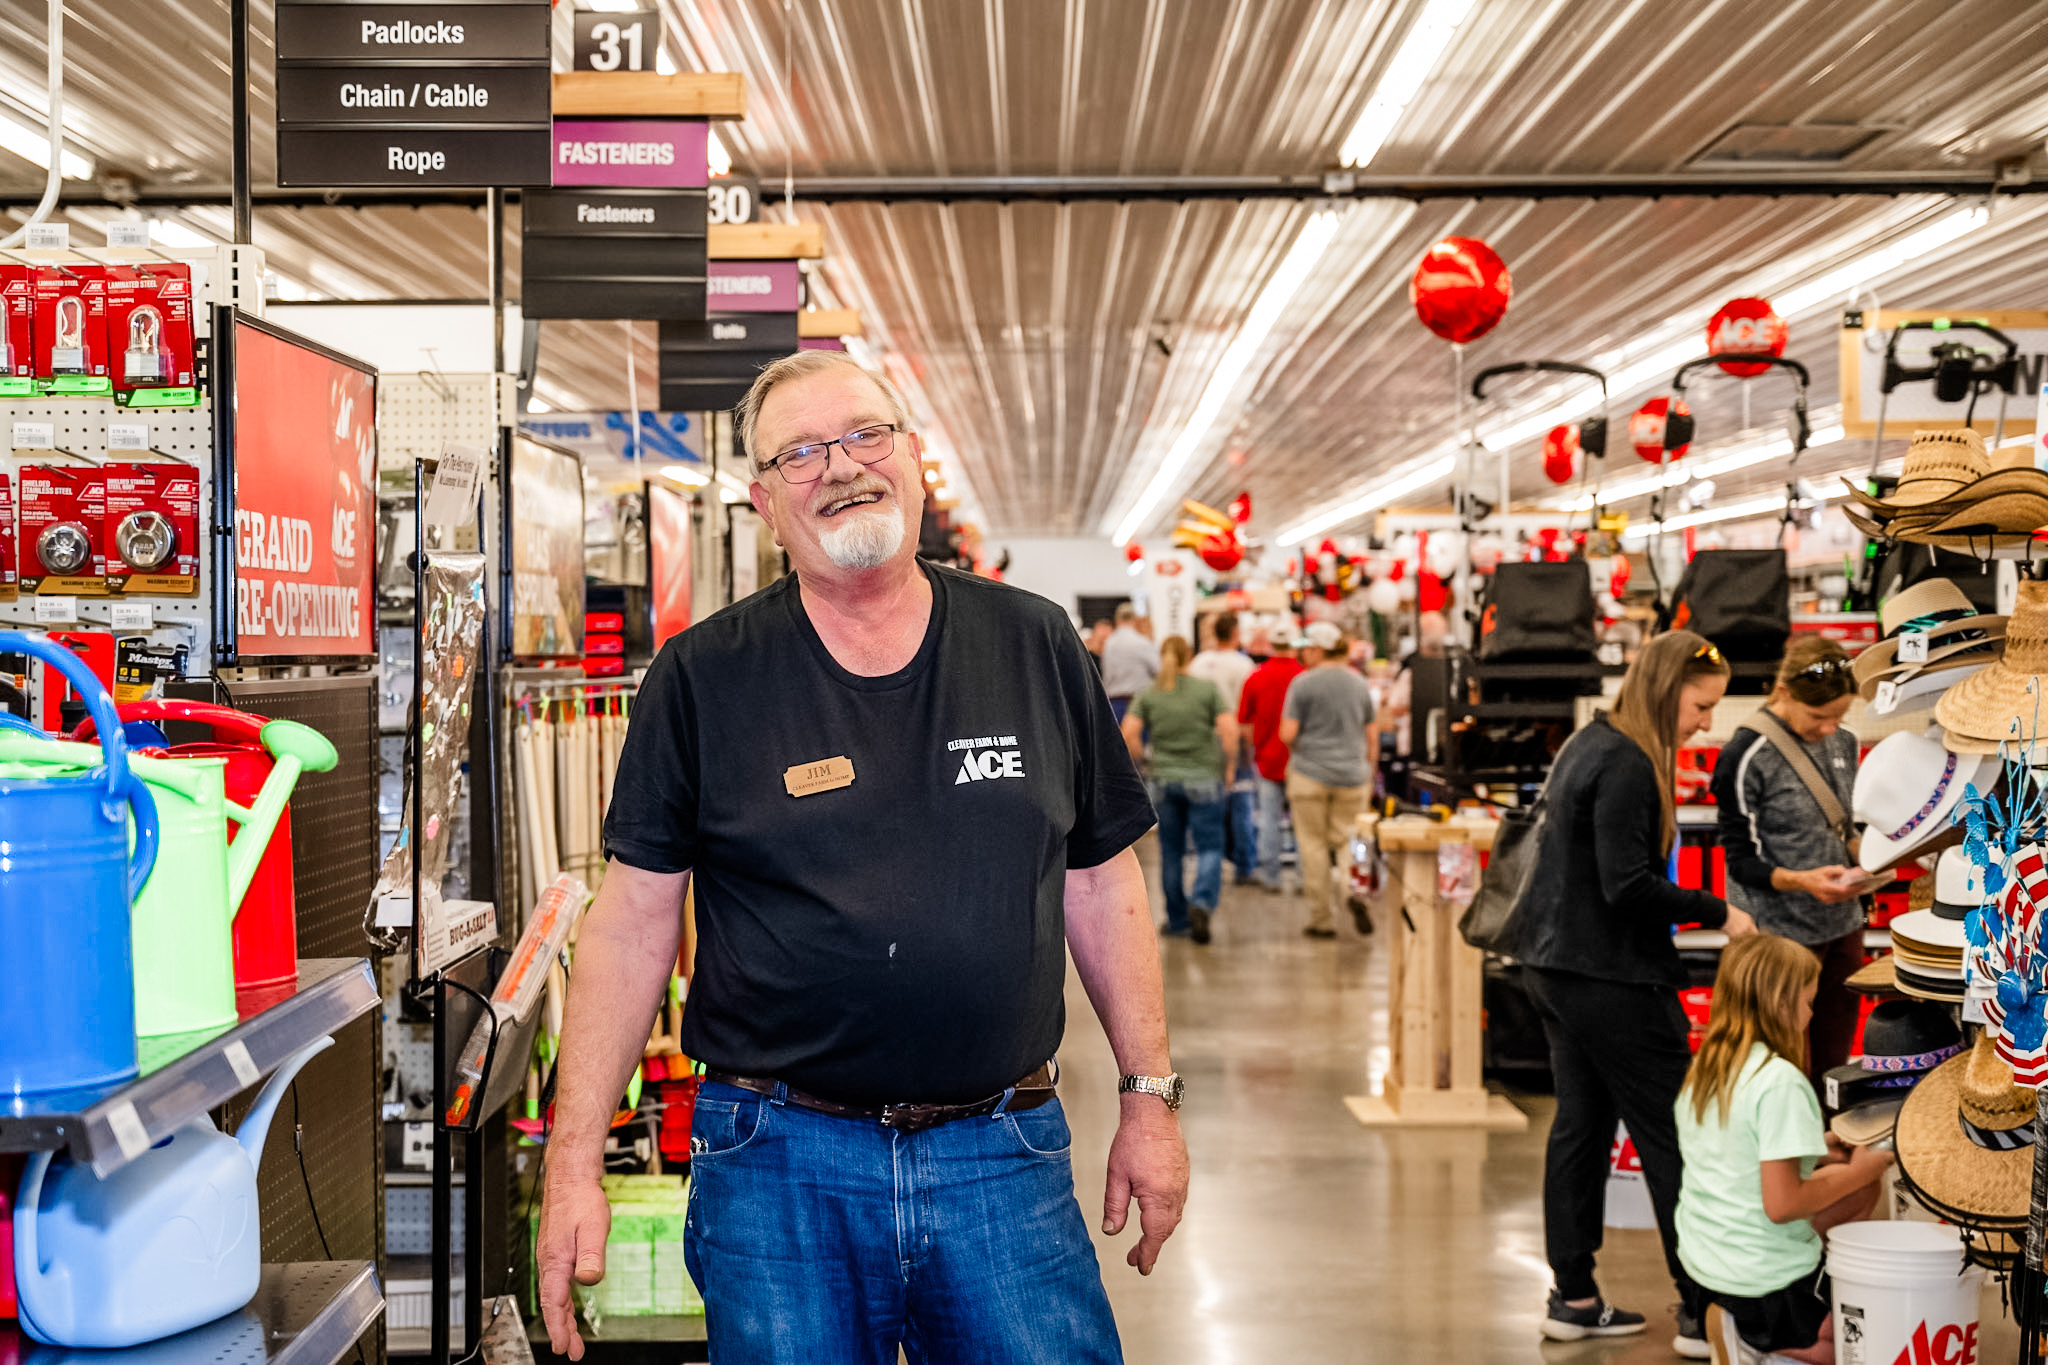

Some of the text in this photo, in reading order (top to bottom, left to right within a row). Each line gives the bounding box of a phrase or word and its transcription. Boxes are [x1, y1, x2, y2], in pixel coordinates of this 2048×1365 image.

[361, 20, 465, 44] Padlocks
[589, 22, 644, 72] 31
[340, 83, 489, 108] Chain / Cable
[387, 147, 446, 175] Rope
[559, 142, 675, 166] FASTENERS
[577, 204, 655, 224] Fasteners
[707, 185, 751, 225] 30
[107, 280, 157, 289] LAMINATED STEEL
[167, 282, 184, 291] ACE
[707, 276, 772, 295] STENERS
[713, 323, 747, 340] Bolts
[1712, 316, 1771, 350] ACE
[22, 487, 73, 496] STAINLESS STEEL
[171, 483, 189, 492] ACE
[236, 508, 313, 573] GRAND
[237, 577, 360, 638] RE-OPENING
[127, 652, 173, 665] Master
[947, 735, 1018, 752] CLEAVER FARM & HOME
[807, 764, 832, 780] JIM
[954, 748, 1026, 786] ACE
[449, 912, 487, 947] BUG-A-SALT
[1892, 1318, 1980, 1365] ACE
